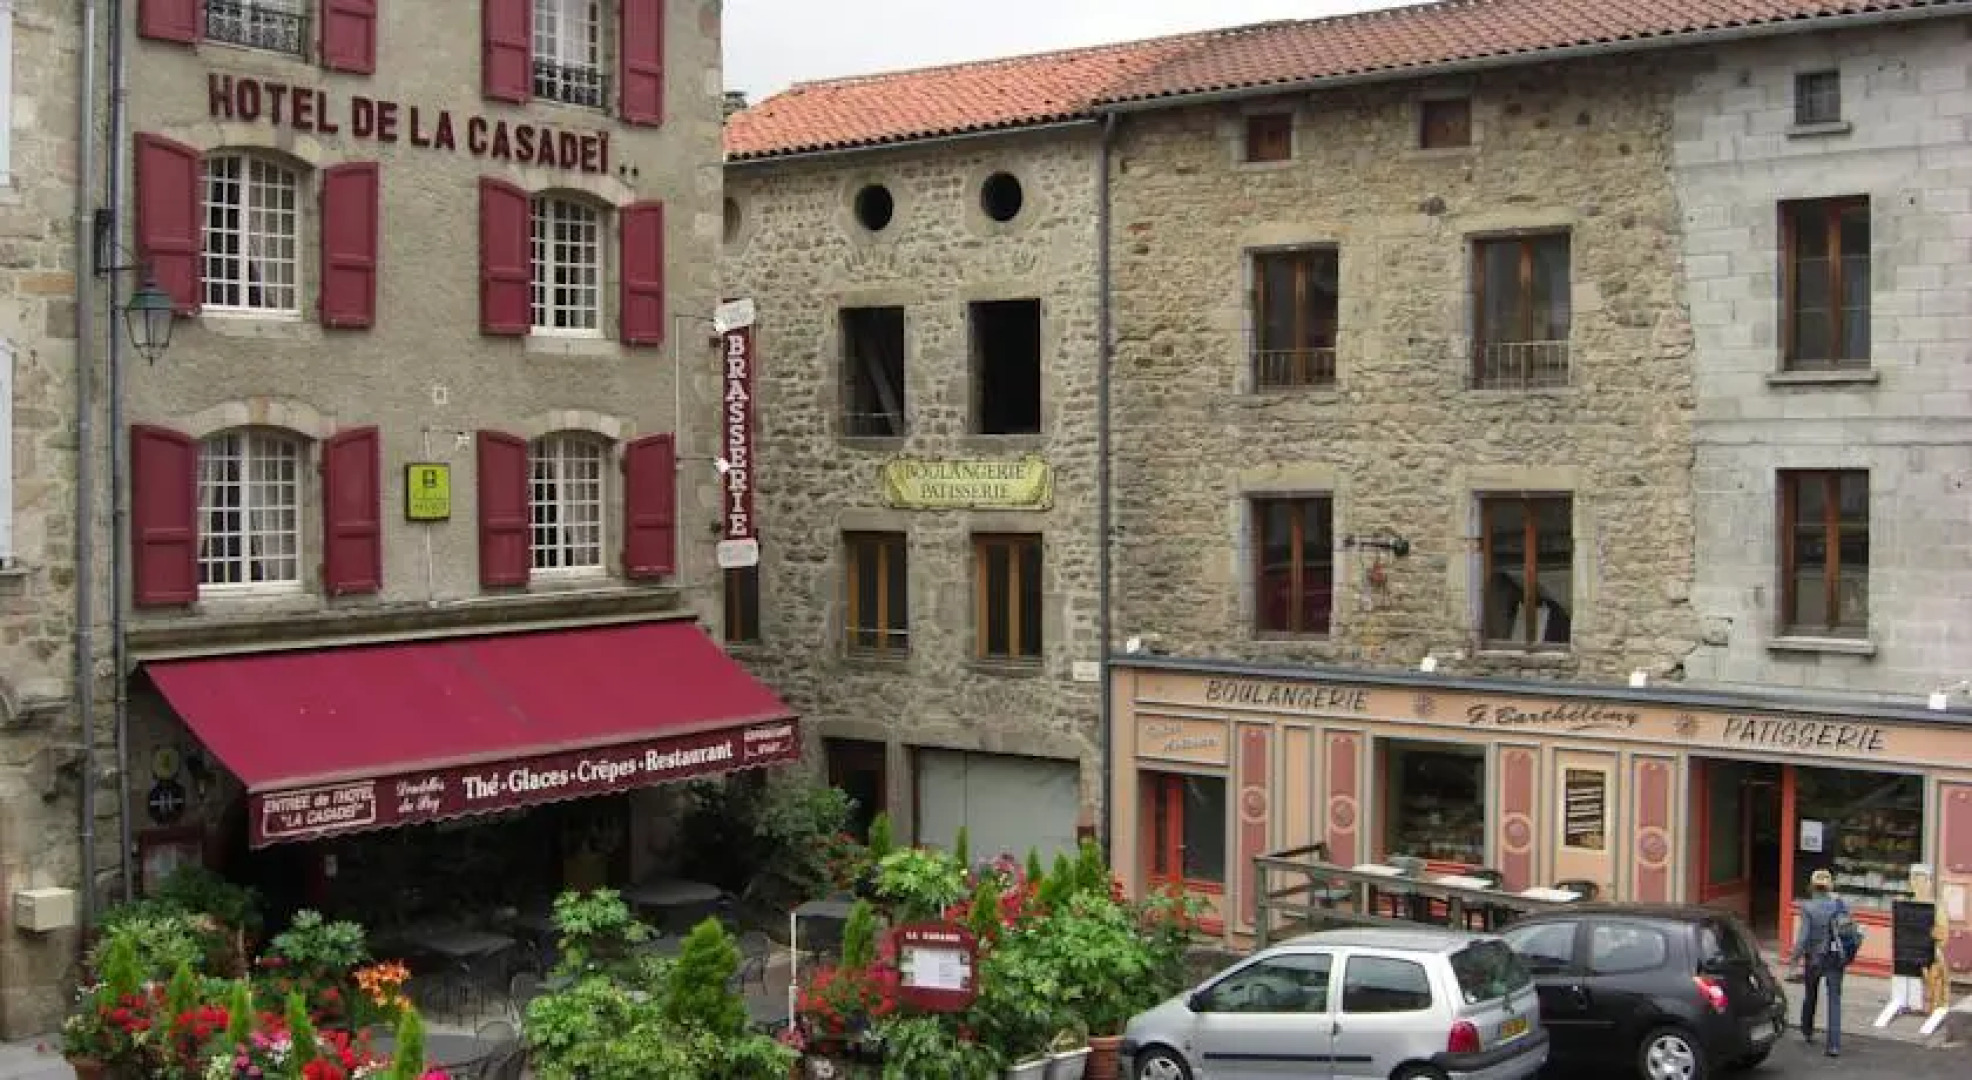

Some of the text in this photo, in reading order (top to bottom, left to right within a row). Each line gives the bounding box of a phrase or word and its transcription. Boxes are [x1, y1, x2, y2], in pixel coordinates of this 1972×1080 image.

[208, 73, 339, 135] HOTEL
[351, 96, 398, 142] DE
[410, 106, 456, 151] LA
[725, 335, 748, 536] BRASSERIE
[906, 464, 1026, 480] BOULANGERIE
[1206, 679, 1369, 711] BOULANGERIE
[1723, 716, 1885, 751] PATISSERIE
[462, 772, 499, 799] Thé
[508, 767, 569, 793] Glaces
[577, 758, 637, 783] Crêpes
[645, 740, 733, 772] Restaurant
